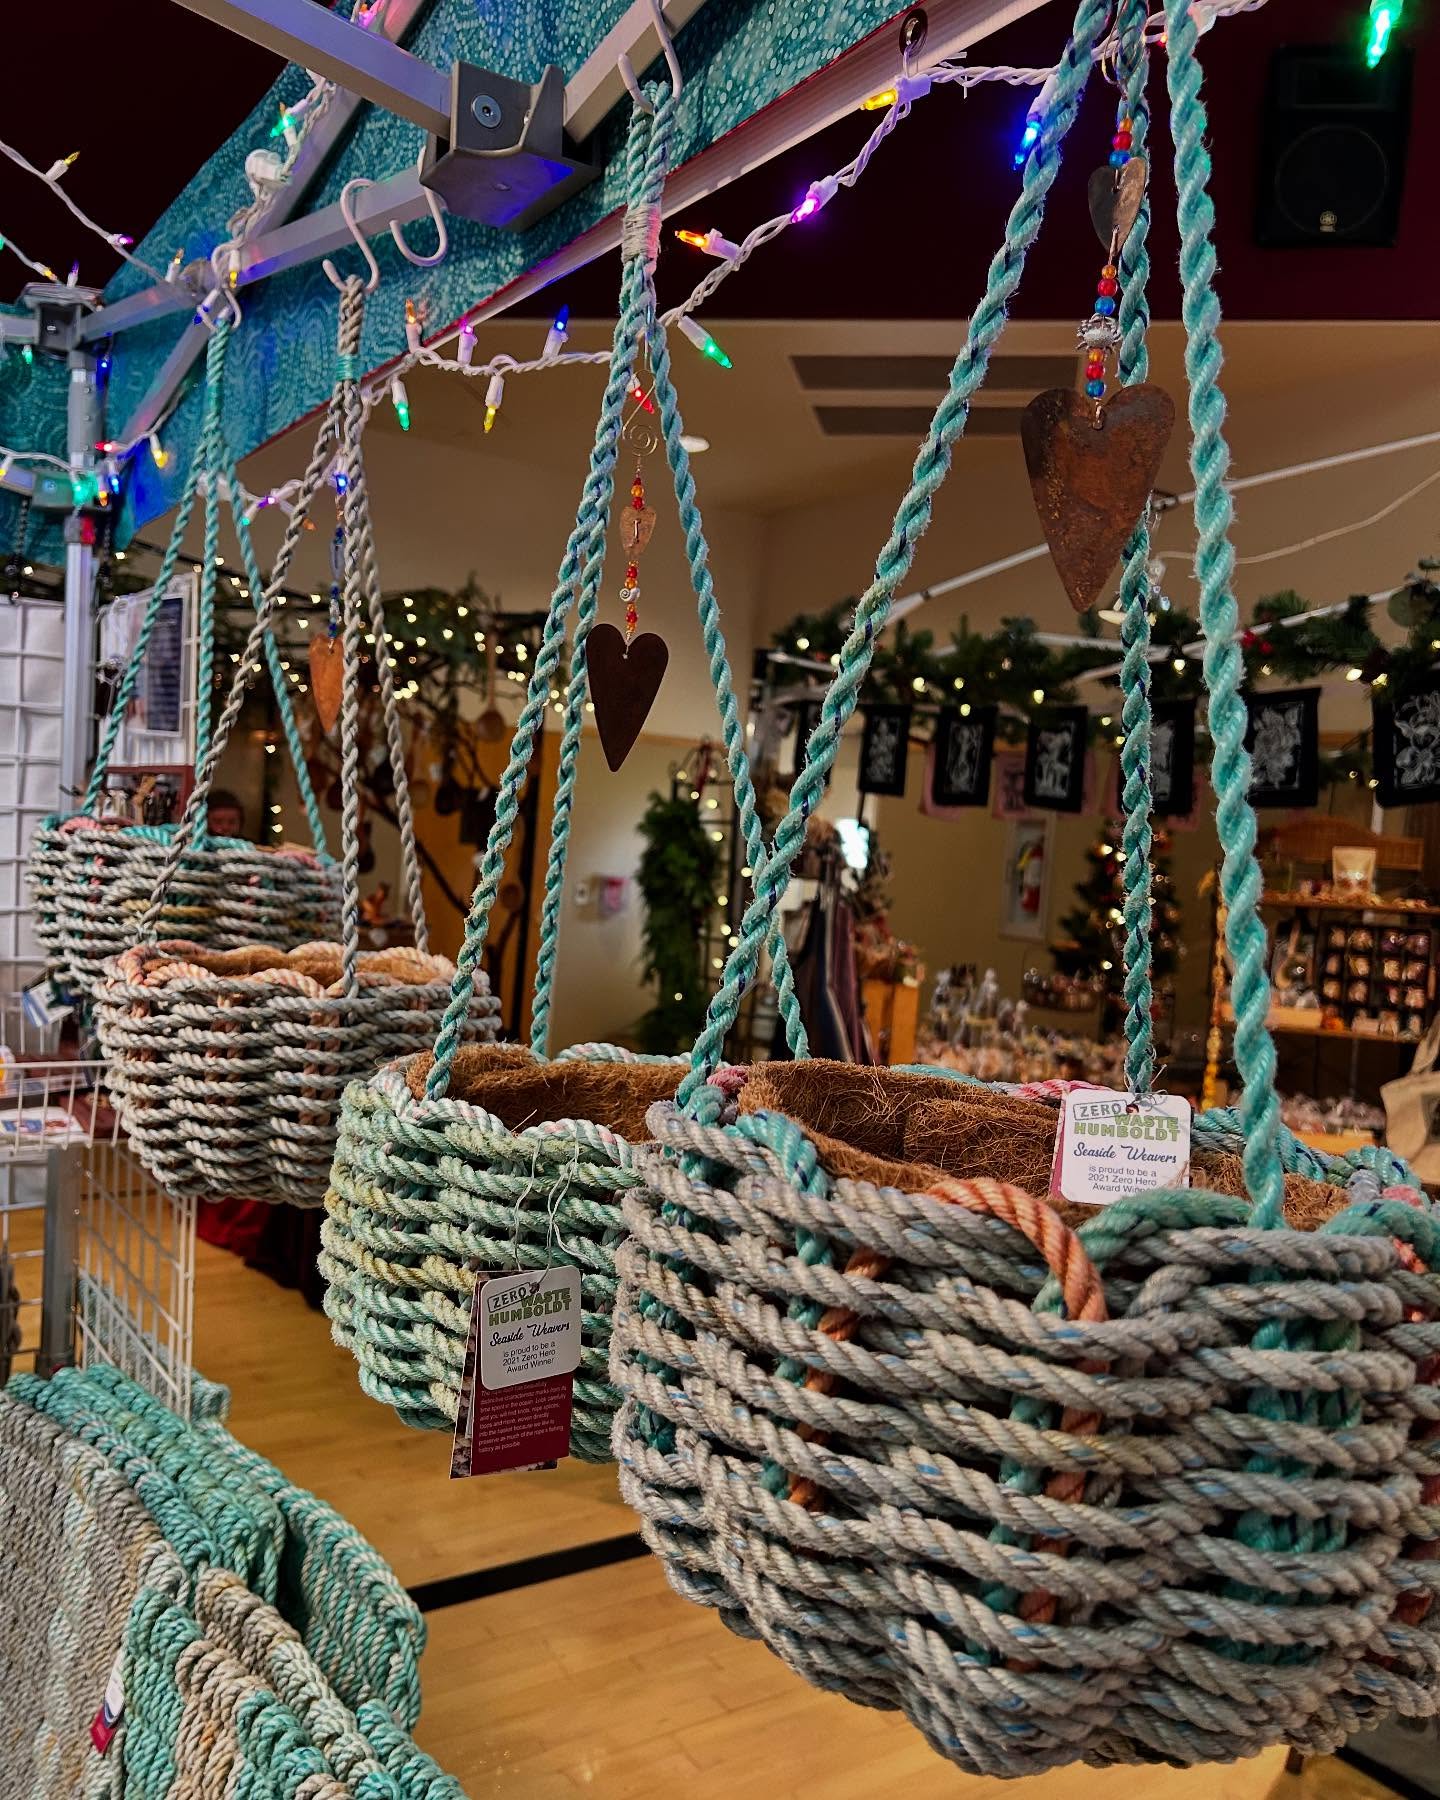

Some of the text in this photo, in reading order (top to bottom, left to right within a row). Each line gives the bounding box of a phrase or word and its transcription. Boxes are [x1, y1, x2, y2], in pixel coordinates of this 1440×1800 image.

[1080, 1103, 1121, 1117] ZERO
[1115, 1114, 1178, 1129] WASTE
[1074, 1122, 1180, 1142] HUMBOLDT
[1074, 1142, 1177, 1163] Seaside Weavers
[1099, 1165, 1124, 1176] proud
[1137, 1168, 1148, 1177] be
[1088, 1173, 1157, 1186] 2021 Zero Hero
[1092, 1183, 1121, 1192] Award
[493, 1287, 527, 1309] ZERO
[521, 1288, 571, 1307] WASTE
[489, 1298, 572, 1326] HUMBOLDT
[490, 1322, 569, 1346] Seaside Weavers
[511, 1345, 531, 1357] proud
[540, 1342, 548, 1350] be
[503, 1350, 556, 1366] 2021 Zero Hero
[507, 1357, 555, 1374] Award Winner
